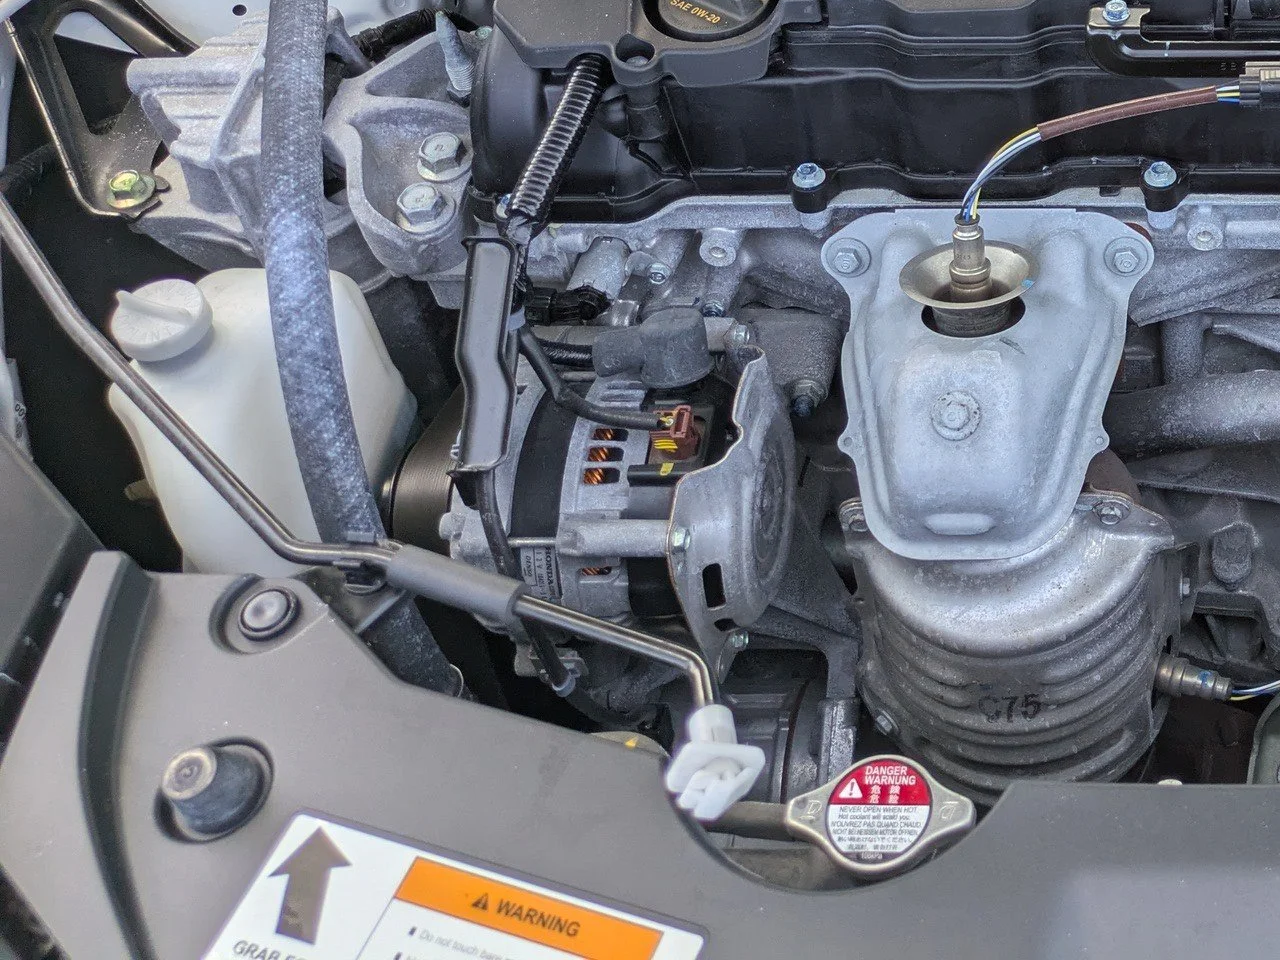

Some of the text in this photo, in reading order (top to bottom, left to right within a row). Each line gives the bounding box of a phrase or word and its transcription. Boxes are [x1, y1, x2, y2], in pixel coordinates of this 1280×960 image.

[690, 6, 721, 24] 0W-20
[545, 546, 554, 585] HONDA
[865, 765, 908, 776] DANGER
[864, 775, 916, 786] WARNUNG
[876, 821, 899, 829] QUAND
[496, 897, 581, 939] WARNING
[420, 928, 434, 943] Do
[435, 935, 450, 948] not
[452, 941, 479, 956] touch
